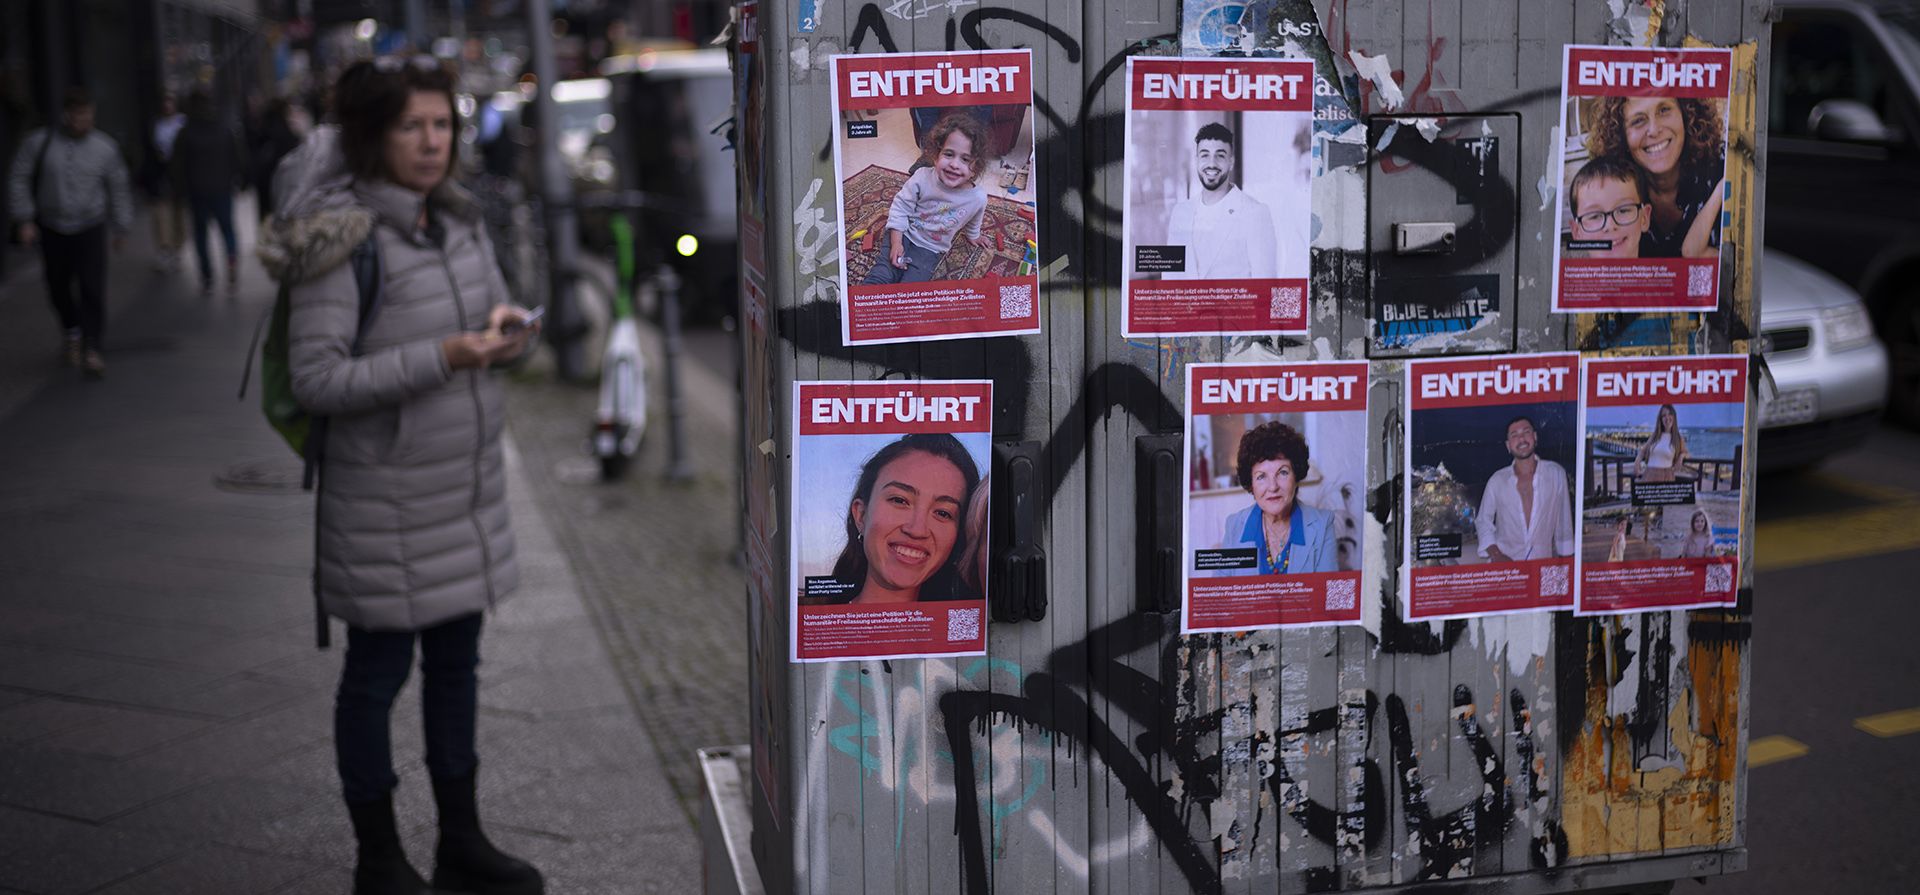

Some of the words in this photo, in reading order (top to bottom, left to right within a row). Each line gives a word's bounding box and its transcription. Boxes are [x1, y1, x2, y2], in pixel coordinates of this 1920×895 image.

[803, 17, 813, 30] 2
[850, 63, 1019, 97] ENTFÜHRT
[1144, 69, 1303, 99] ENTFÜHRT
[1579, 58, 1721, 87] ENTFÜHRT
[1383, 303, 1428, 321] BLUE
[1202, 372, 1357, 403] ENTFÜHRT
[1422, 365, 1569, 398] ENTFÜHRT
[1597, 366, 1737, 396] ENTFÜHRT
[812, 391, 980, 423] ENTFÜHRT
